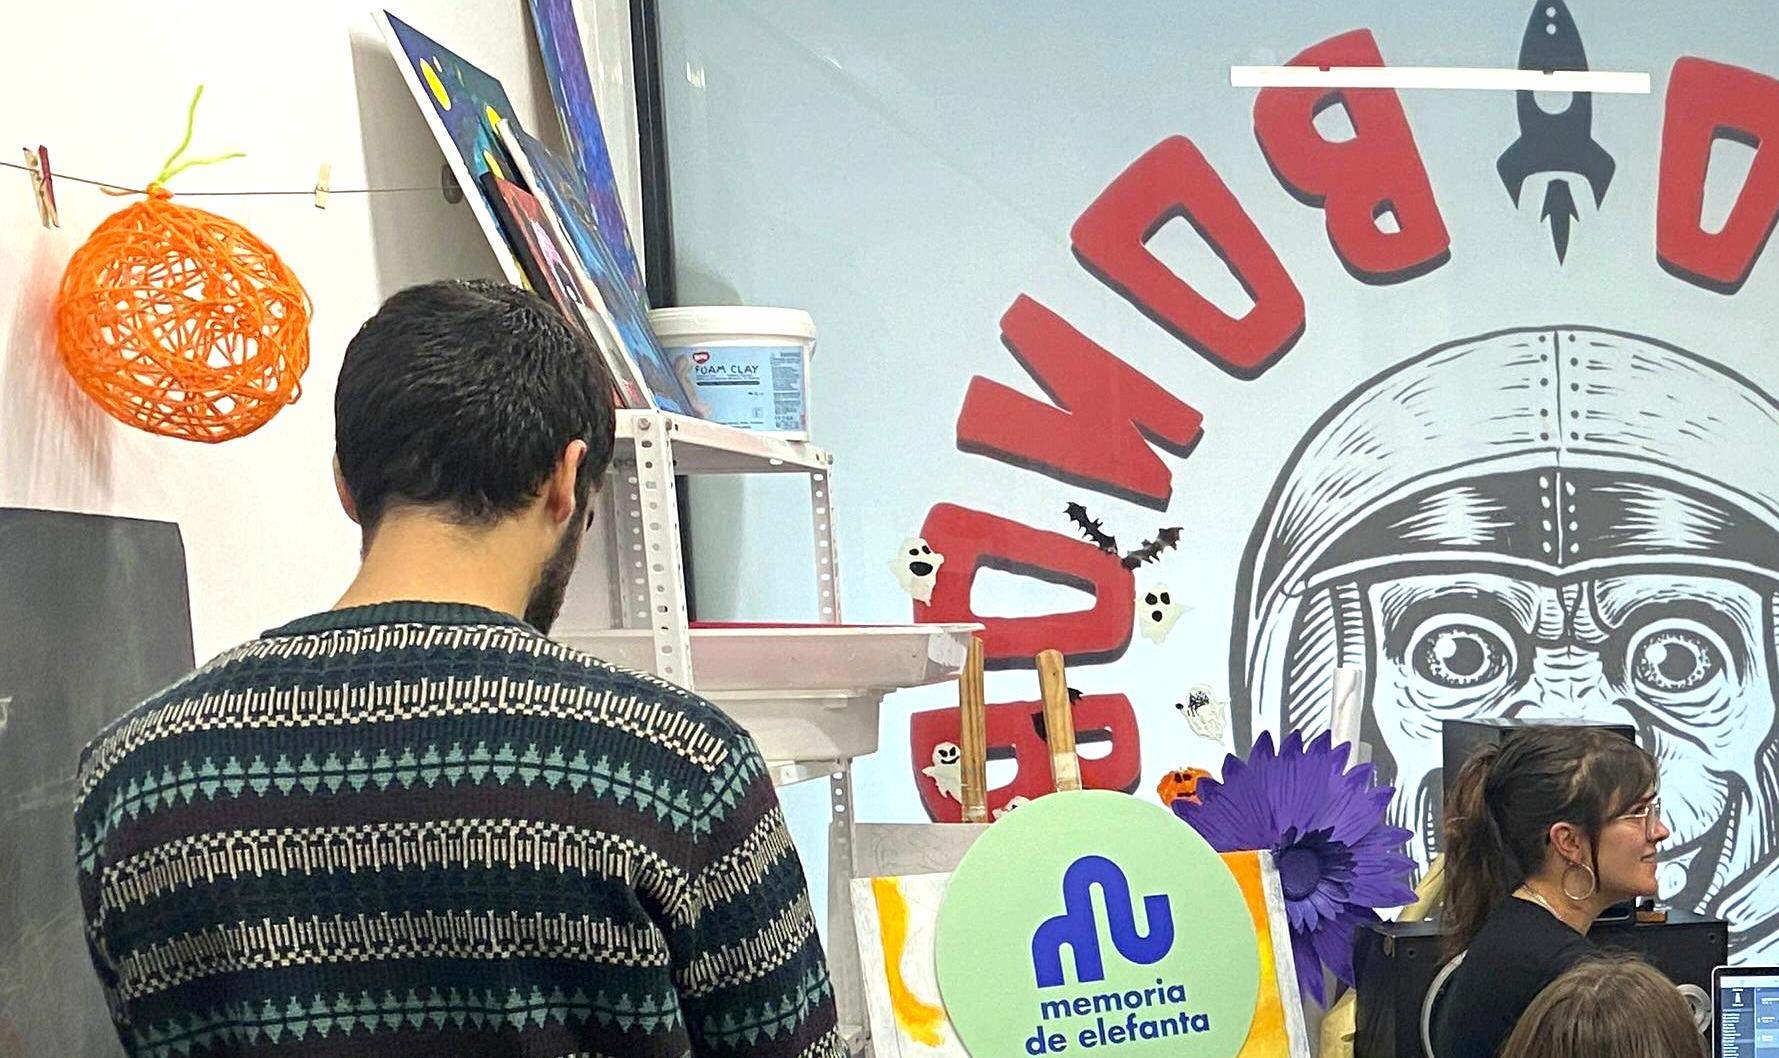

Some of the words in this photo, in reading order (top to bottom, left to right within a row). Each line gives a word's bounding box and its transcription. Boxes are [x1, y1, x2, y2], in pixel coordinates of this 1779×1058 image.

[695, 365, 727, 375] FOAM
[730, 365, 759, 374] CLAY
[1040, 977, 1187, 1021] memoria
[1025, 1025, 1068, 1056] de
[1078, 1011, 1211, 1048] elefanta
